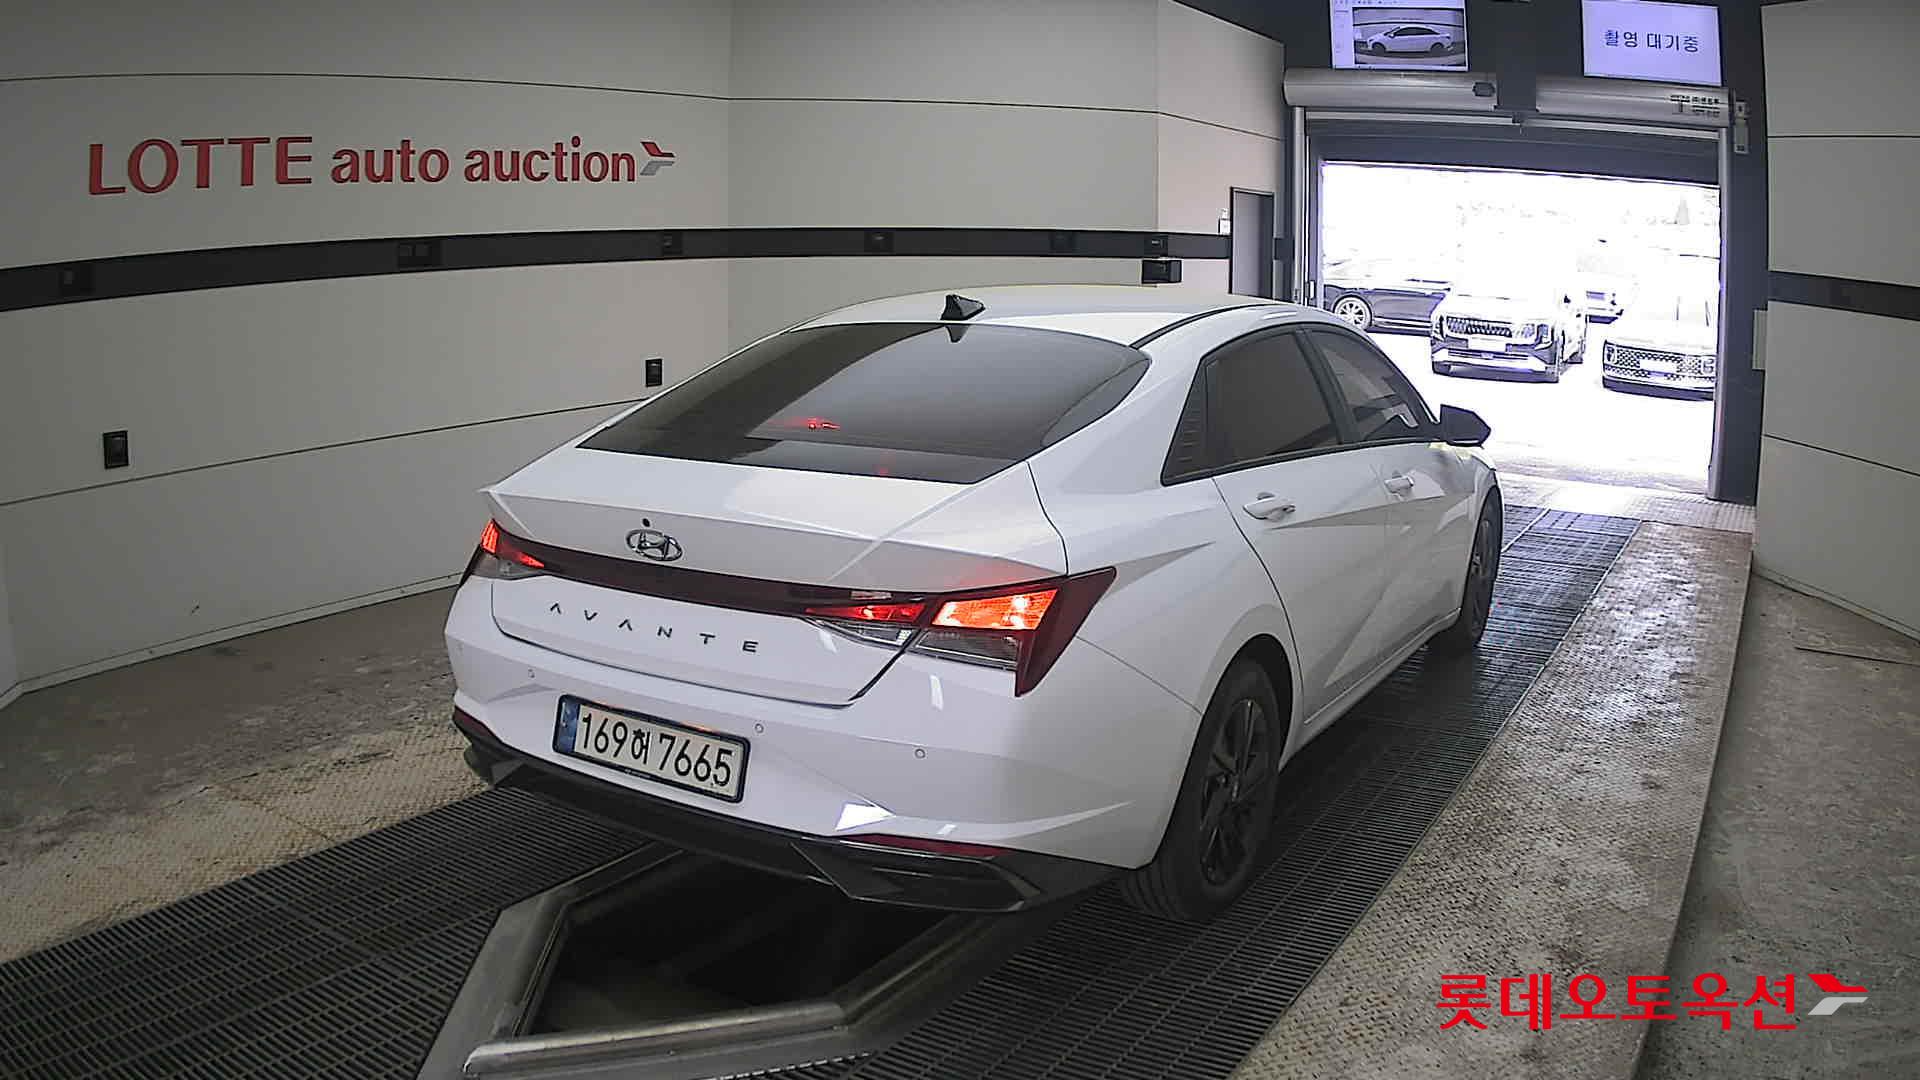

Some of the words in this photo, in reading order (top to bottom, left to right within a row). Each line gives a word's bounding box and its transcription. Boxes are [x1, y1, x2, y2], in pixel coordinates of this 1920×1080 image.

[1604, 30, 1639, 48] 촬영
[1647, 33, 1698, 52] 대기중
[88, 136, 313, 195] LOTTE
[331, 140, 449, 184] auto
[464, 136, 636, 183] auction
[549, 602, 760, 653] AVANTE
